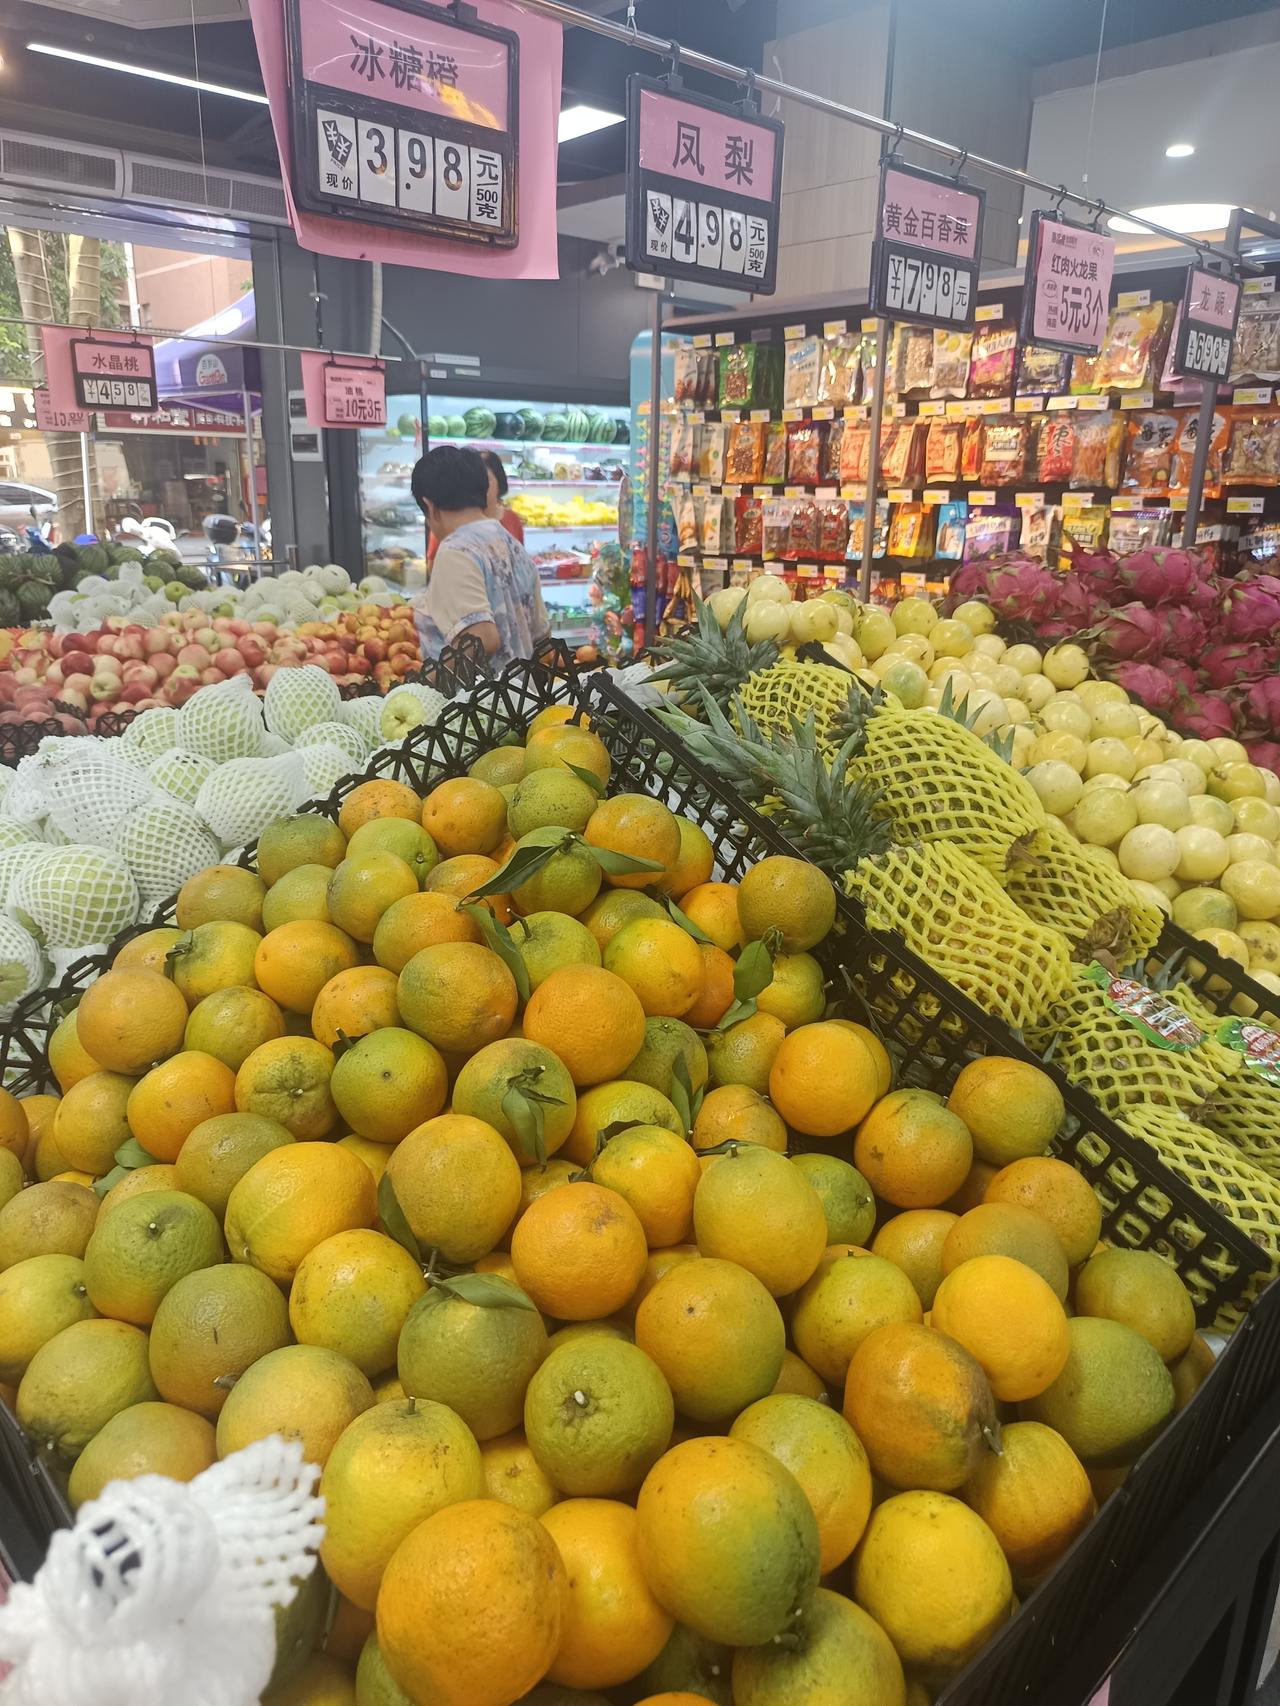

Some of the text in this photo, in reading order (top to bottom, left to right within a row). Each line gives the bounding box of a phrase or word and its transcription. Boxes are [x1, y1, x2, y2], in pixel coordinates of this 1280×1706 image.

[350, 35, 459, 92] 冰糖橙
[366, 127, 463, 192] 3.98
[672, 120, 754, 186] 凤梨
[326, 173, 354, 192] 现价
[673, 201, 743, 255] 4.98
[885, 202, 969, 246] 黄金百香果
[650, 240, 668, 253] 现价
[1051, 254, 1098, 281] 红肉火龙果
[1060, 285, 1103, 336] 5元3个
[92, 353, 139, 372] 水晶桃
[346, 399, 381, 421] 10元3斤
